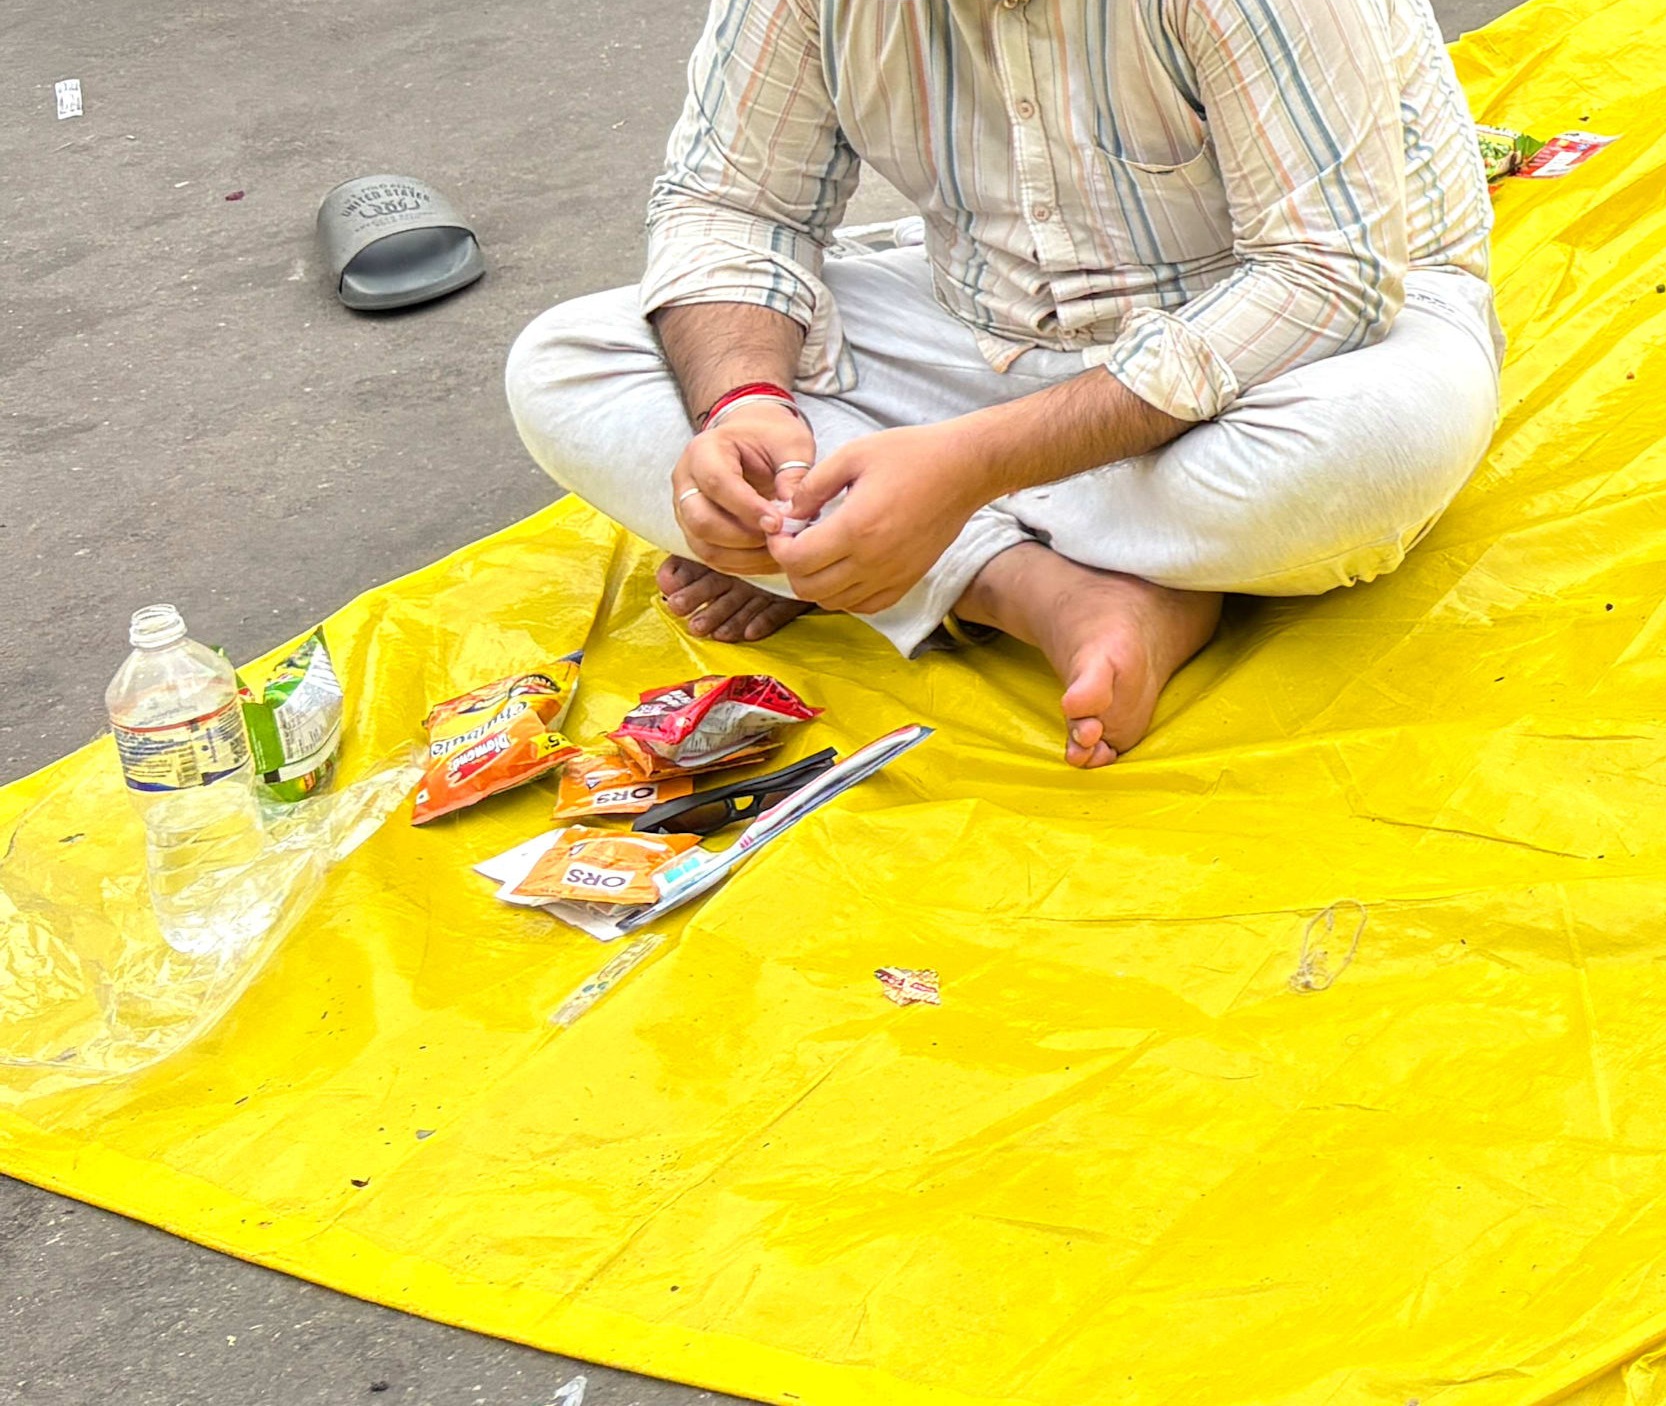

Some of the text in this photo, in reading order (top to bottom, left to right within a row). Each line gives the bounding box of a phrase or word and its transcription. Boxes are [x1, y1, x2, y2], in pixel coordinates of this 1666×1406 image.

[341, 188, 382, 218] UNITED
[385, 187, 431, 203] STATES
[451, 732, 511, 772] Diamond
[596, 787, 656, 806] ORS
[566, 869, 627, 889] ORS
